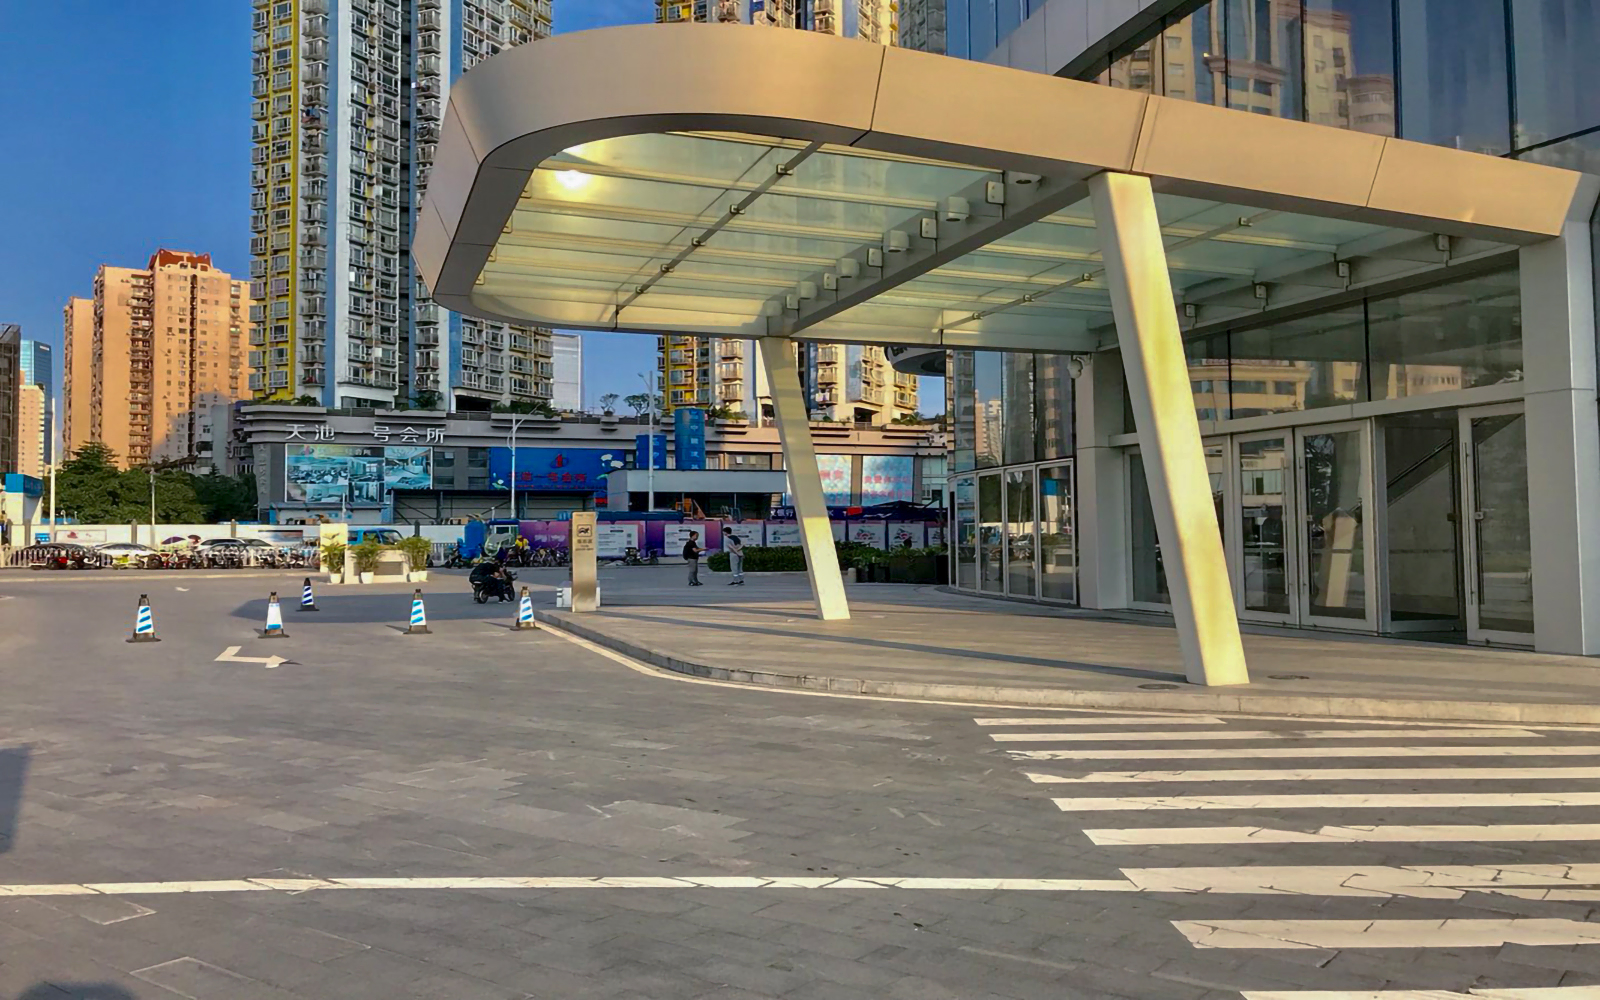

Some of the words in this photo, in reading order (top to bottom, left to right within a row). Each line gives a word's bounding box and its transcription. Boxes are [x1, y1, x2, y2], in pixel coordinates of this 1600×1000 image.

[284, 423, 447, 444] 天池一号会所
